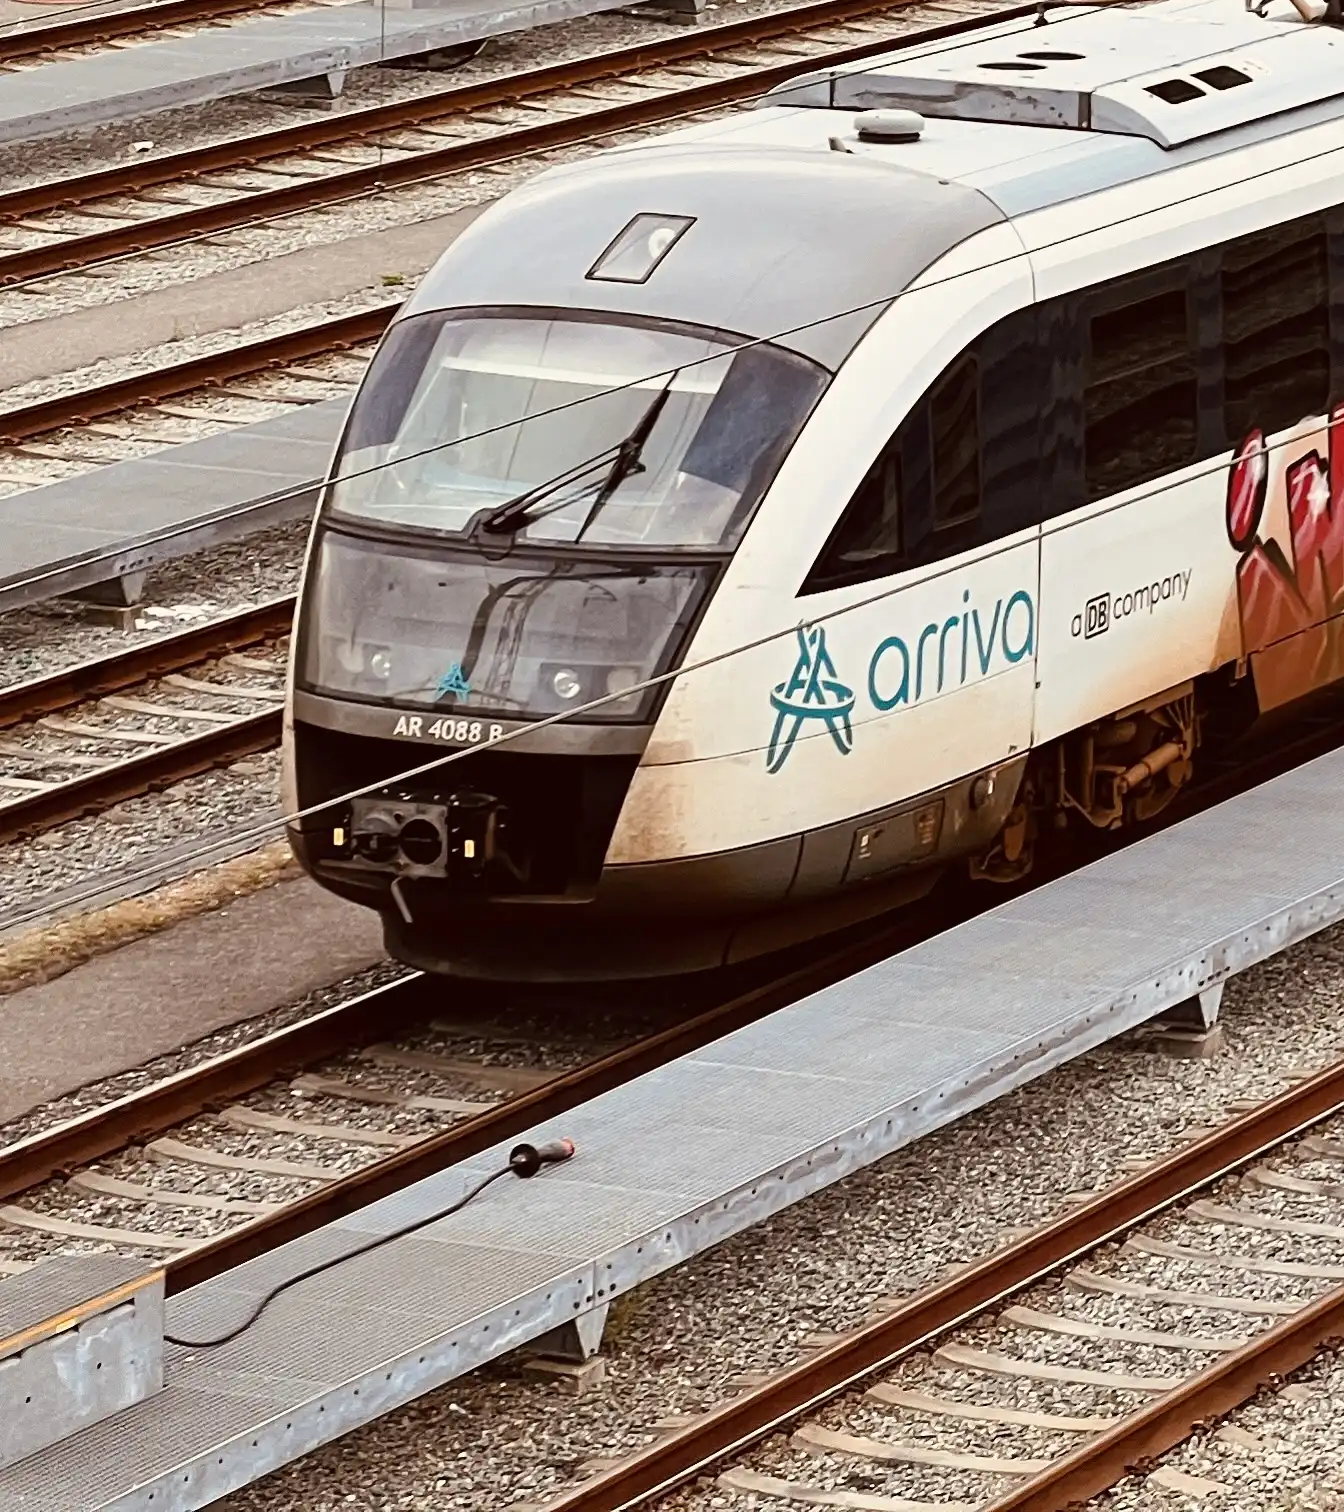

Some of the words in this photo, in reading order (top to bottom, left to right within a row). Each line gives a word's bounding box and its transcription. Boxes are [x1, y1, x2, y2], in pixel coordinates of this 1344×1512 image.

[1071, 612, 1082, 638] a
[1086, 597, 1108, 635] DB
[1112, 567, 1193, 621] company
[867, 589, 1035, 712] arriva
[392, 715, 423, 738] AR
[427, 718, 483, 743] 4088
[488, 723, 504, 742] B
